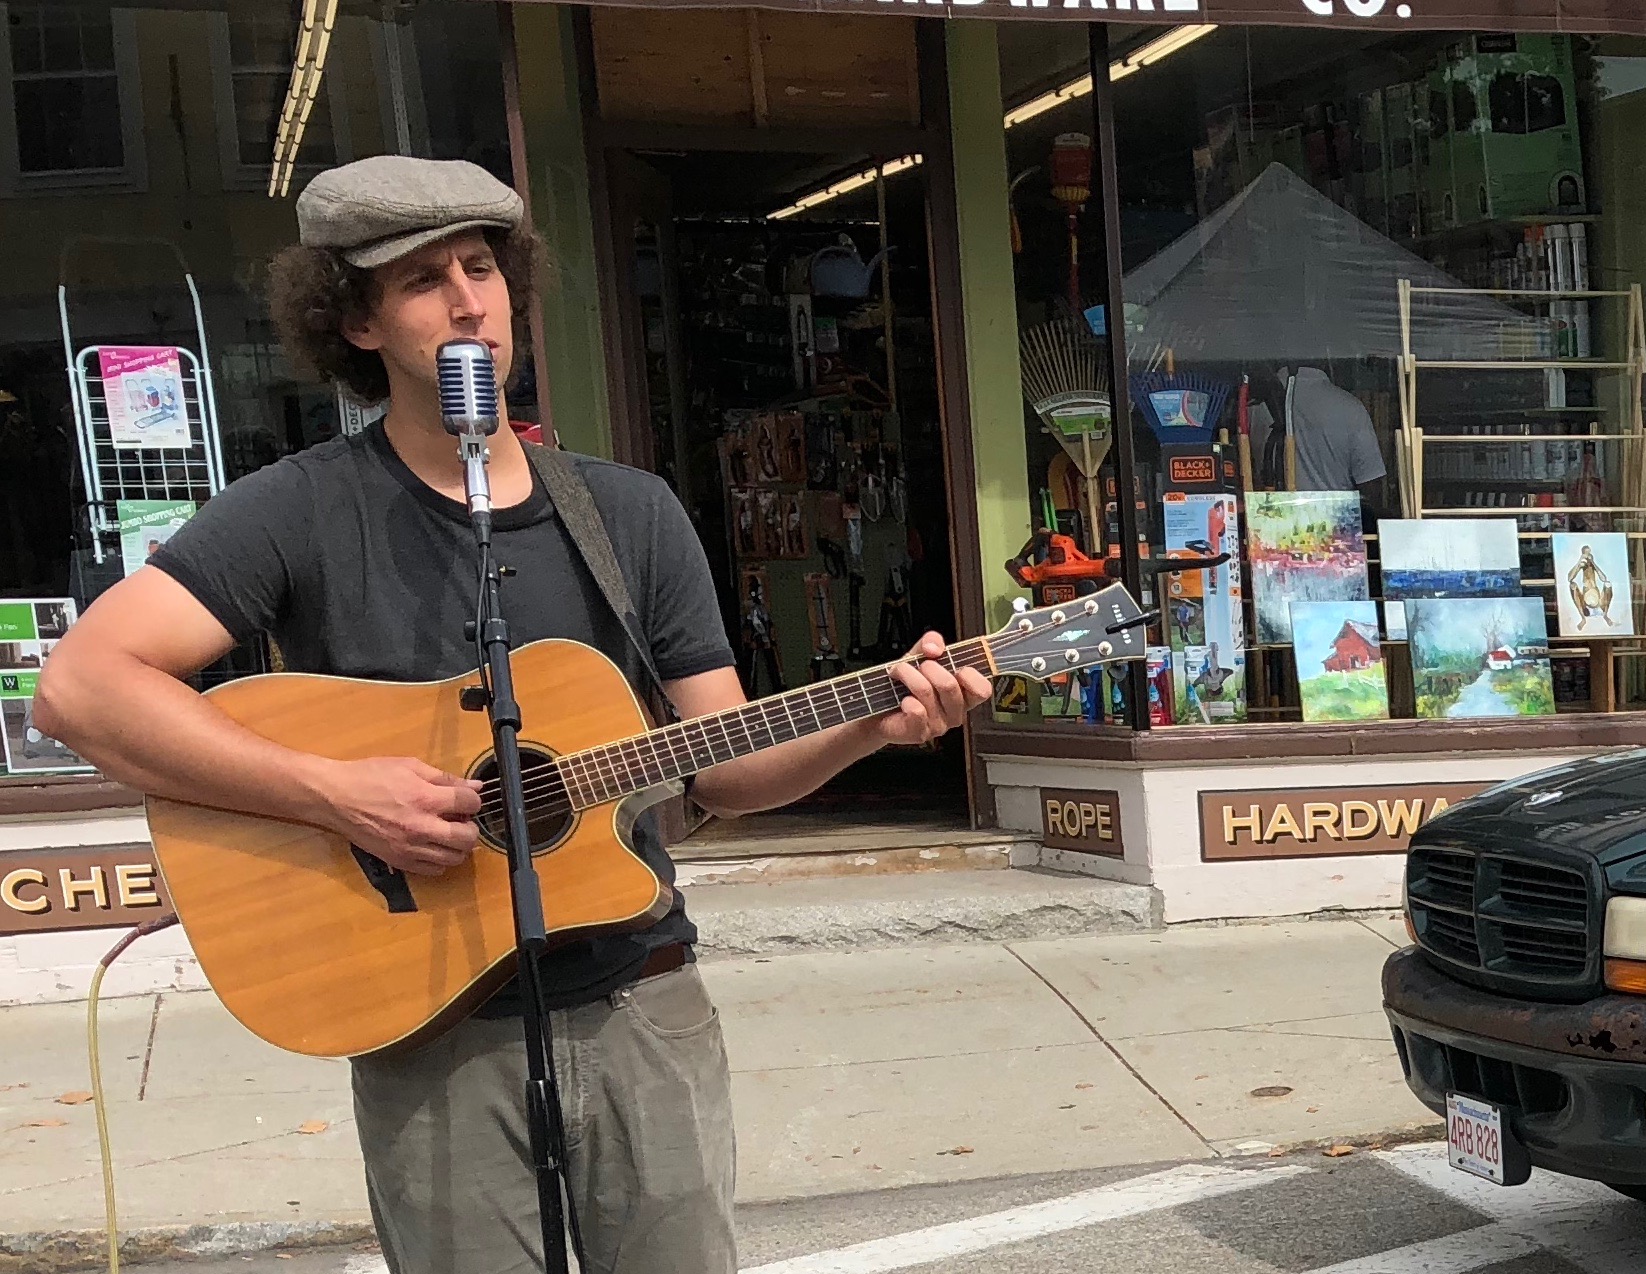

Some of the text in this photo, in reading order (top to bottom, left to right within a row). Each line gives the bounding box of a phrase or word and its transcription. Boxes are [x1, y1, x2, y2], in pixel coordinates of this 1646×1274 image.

[1174, 470, 1211, 478] DECKER
[1047, 799, 1113, 841] ROPE
[1450, 1115, 1499, 1166] 4RB 828
